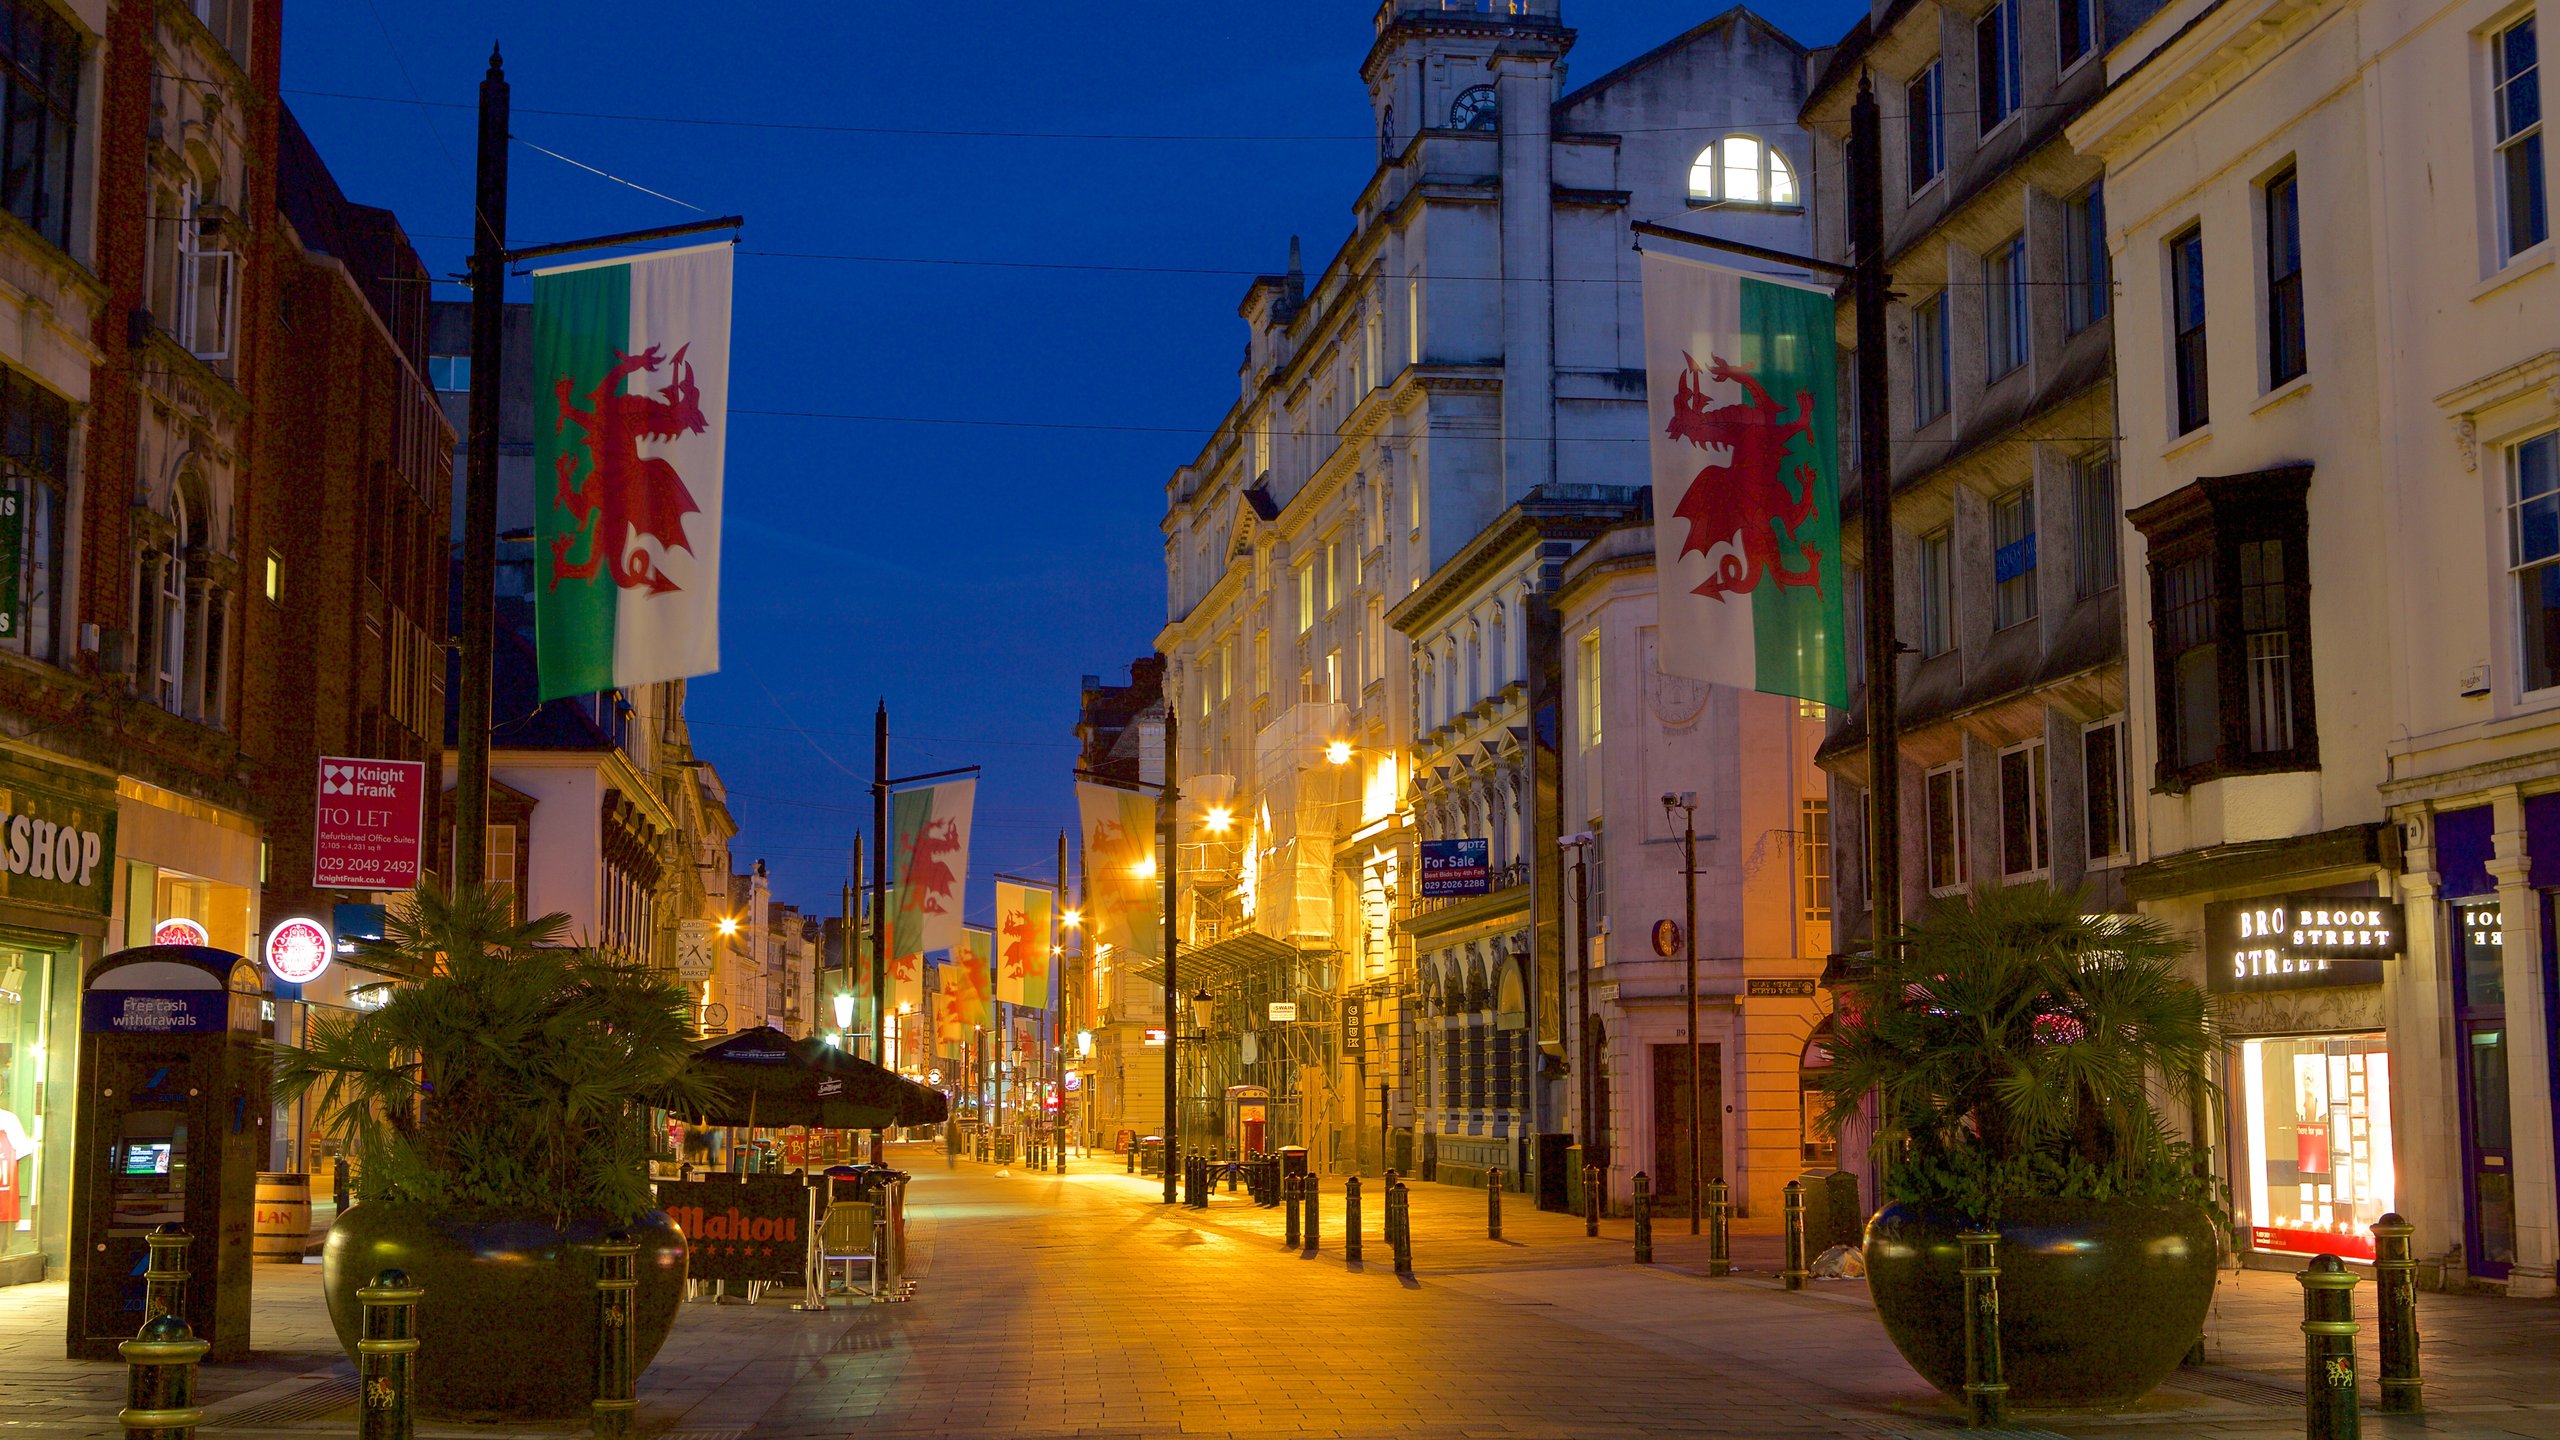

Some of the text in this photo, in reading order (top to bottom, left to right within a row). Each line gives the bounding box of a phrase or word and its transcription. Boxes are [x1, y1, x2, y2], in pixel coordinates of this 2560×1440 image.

[357, 766, 405, 785] Knight
[356, 783, 397, 798] Frank
[320, 808, 393, 828] TO LET
[320, 832, 416, 844] Refurbished Office Suites
[320, 857, 415, 873] 029 2049 2492
[1424, 856, 1475, 869] For Sale
[318, 873, 386, 884] KnightFrank.co.uk
[1424, 871, 1439, 879] Best
[1440, 870, 1453, 878] Bids
[1454, 870, 1462, 878] by
[1473, 868, 1486, 876] Feb
[1424, 879, 1485, 890] 029 2026 2288
[2300, 910, 2382, 927] BROOK
[2292, 929, 2391, 946] STREET
[123, 999, 187, 1012] Free cash
[112, 1014, 197, 1027] withdrawals
[666, 1206, 797, 1243] Mahou
